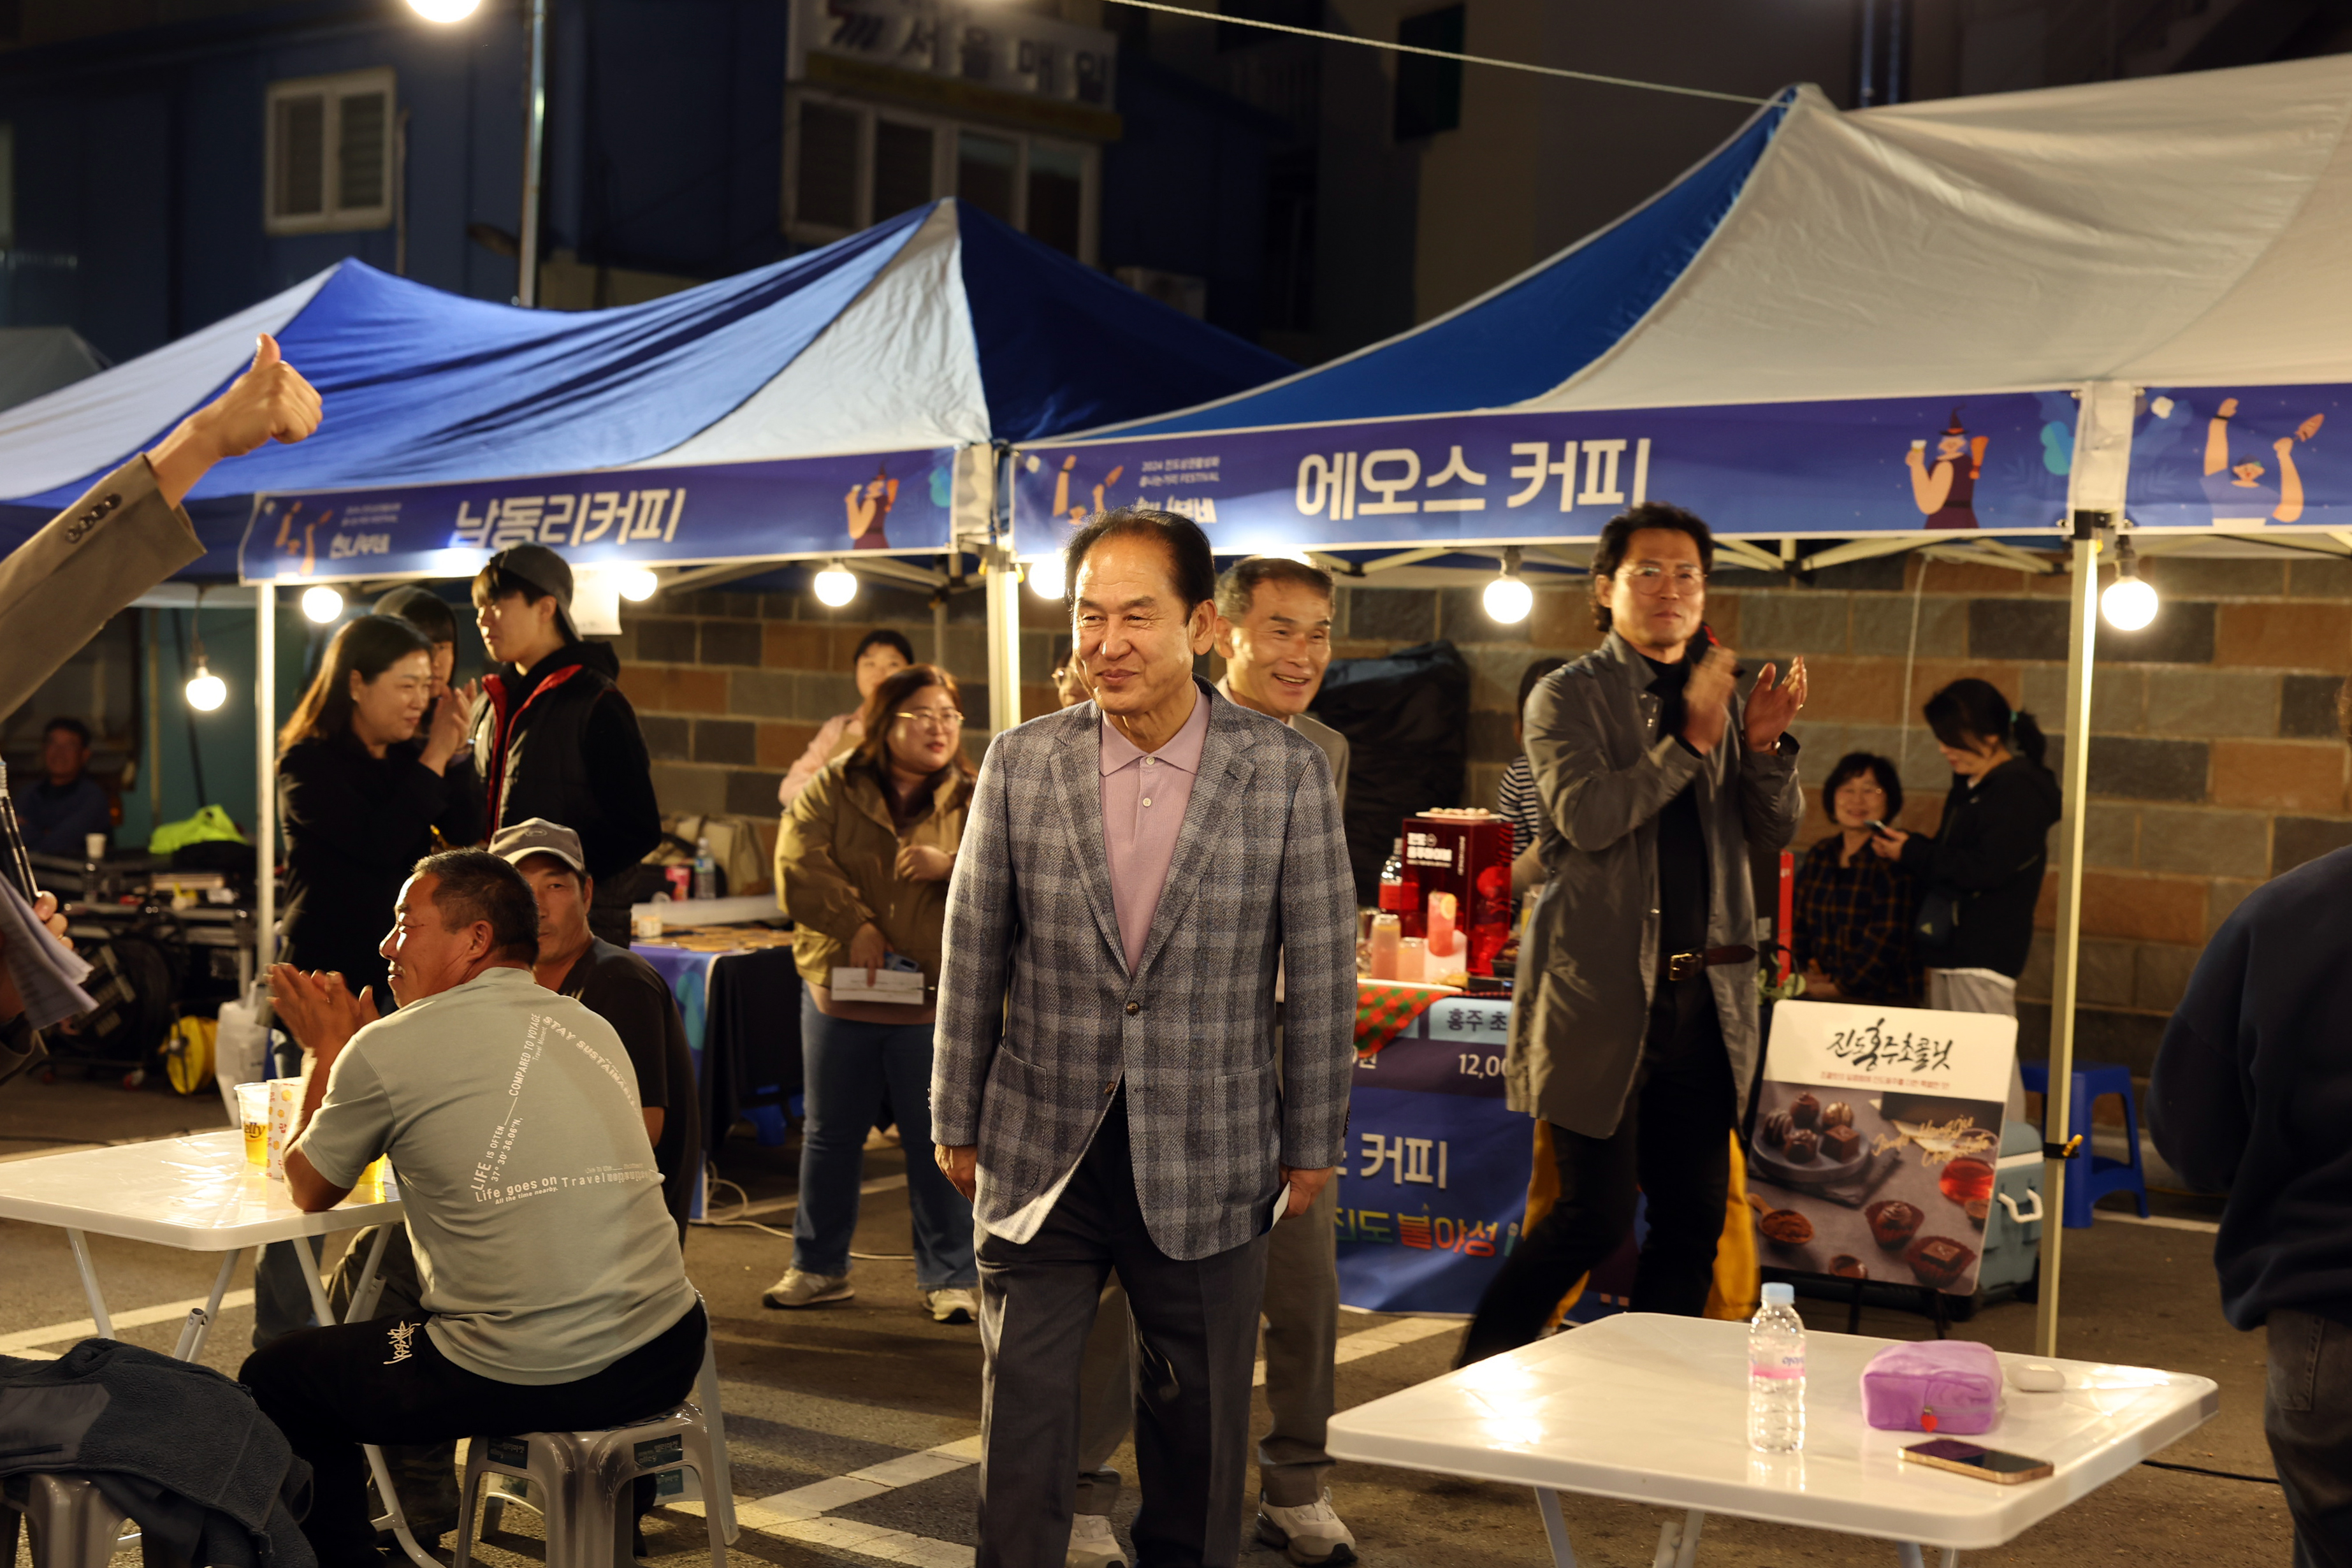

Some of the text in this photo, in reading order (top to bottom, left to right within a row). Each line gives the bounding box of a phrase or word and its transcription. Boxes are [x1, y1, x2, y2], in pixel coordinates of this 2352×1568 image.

[1295, 437, 1651, 521] 에오스 커피
[543, 1016, 577, 1041] STAY
[1447, 1008, 1484, 1033] 홍주
[524, 1040, 535, 1050] TO
[532, 1026, 548, 1061] Travel Moment
[509, 1052, 531, 1096] COMPARED
[243, 1121, 266, 1138] elly
[490, 1125, 505, 1149] OFTEN
[486, 1151, 495, 1159] IS
[1360, 1133, 1448, 1189] 커피
[470, 1162, 491, 1191] LIFE
[475, 1187, 501, 1203] Life
[506, 1180, 538, 1196] goes
[541, 1175, 558, 1187] on
[561, 1172, 606, 1187] Travel
